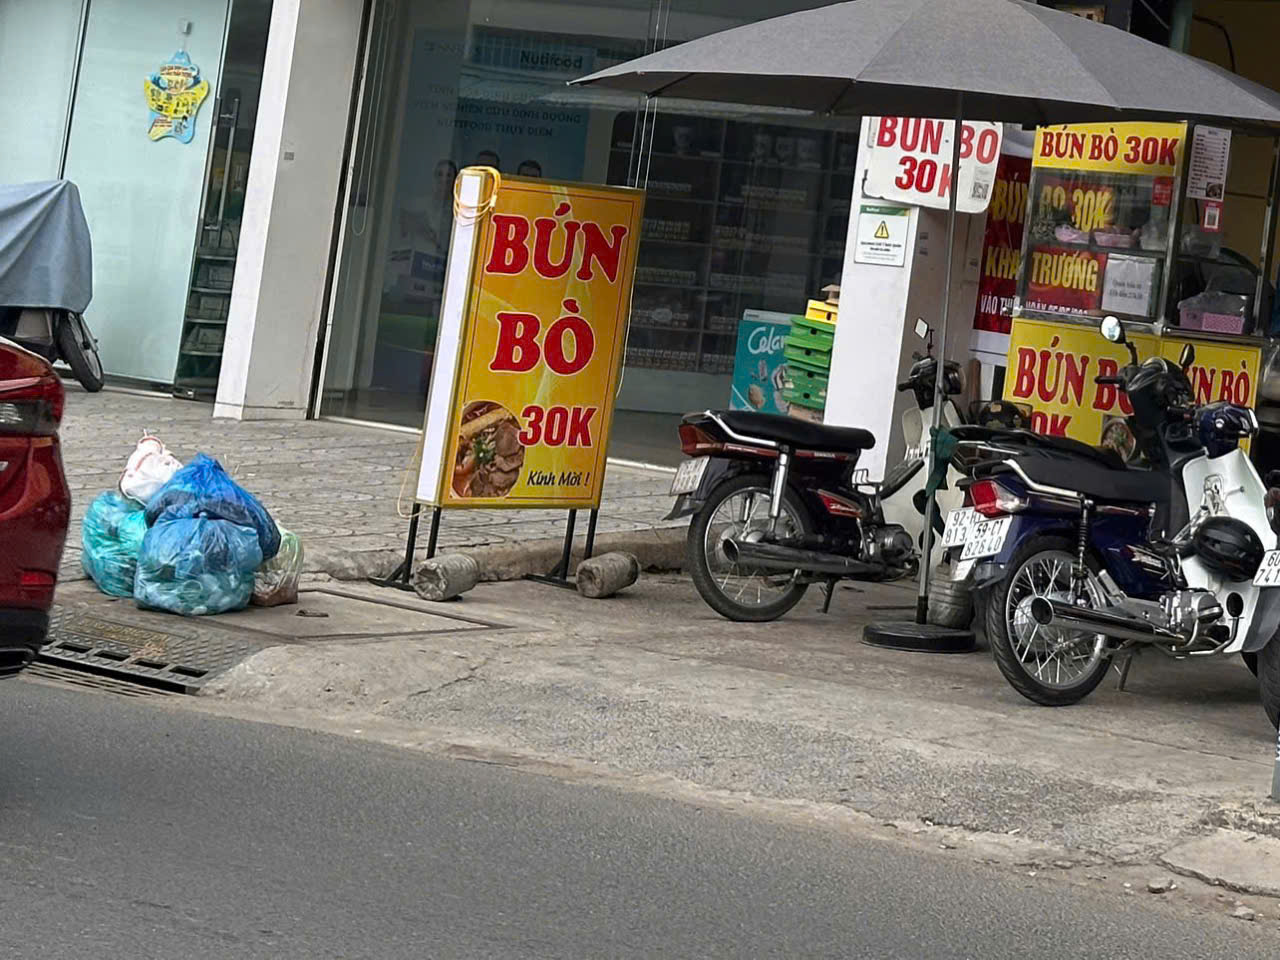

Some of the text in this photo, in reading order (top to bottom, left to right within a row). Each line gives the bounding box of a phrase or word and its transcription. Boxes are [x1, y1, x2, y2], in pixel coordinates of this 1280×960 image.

[1040, 126, 1086, 159] BÚN
[1088, 128, 1119, 161] BÒ
[1124, 136, 1179, 166] 30K
[485, 203, 628, 285] BÚN
[489, 299, 596, 376] BÒ
[1013, 336, 1089, 407] BÚN
[518, 405, 597, 448] 30K
[526, 469, 555, 487] Kính
[557, 470, 583, 487] Mời
